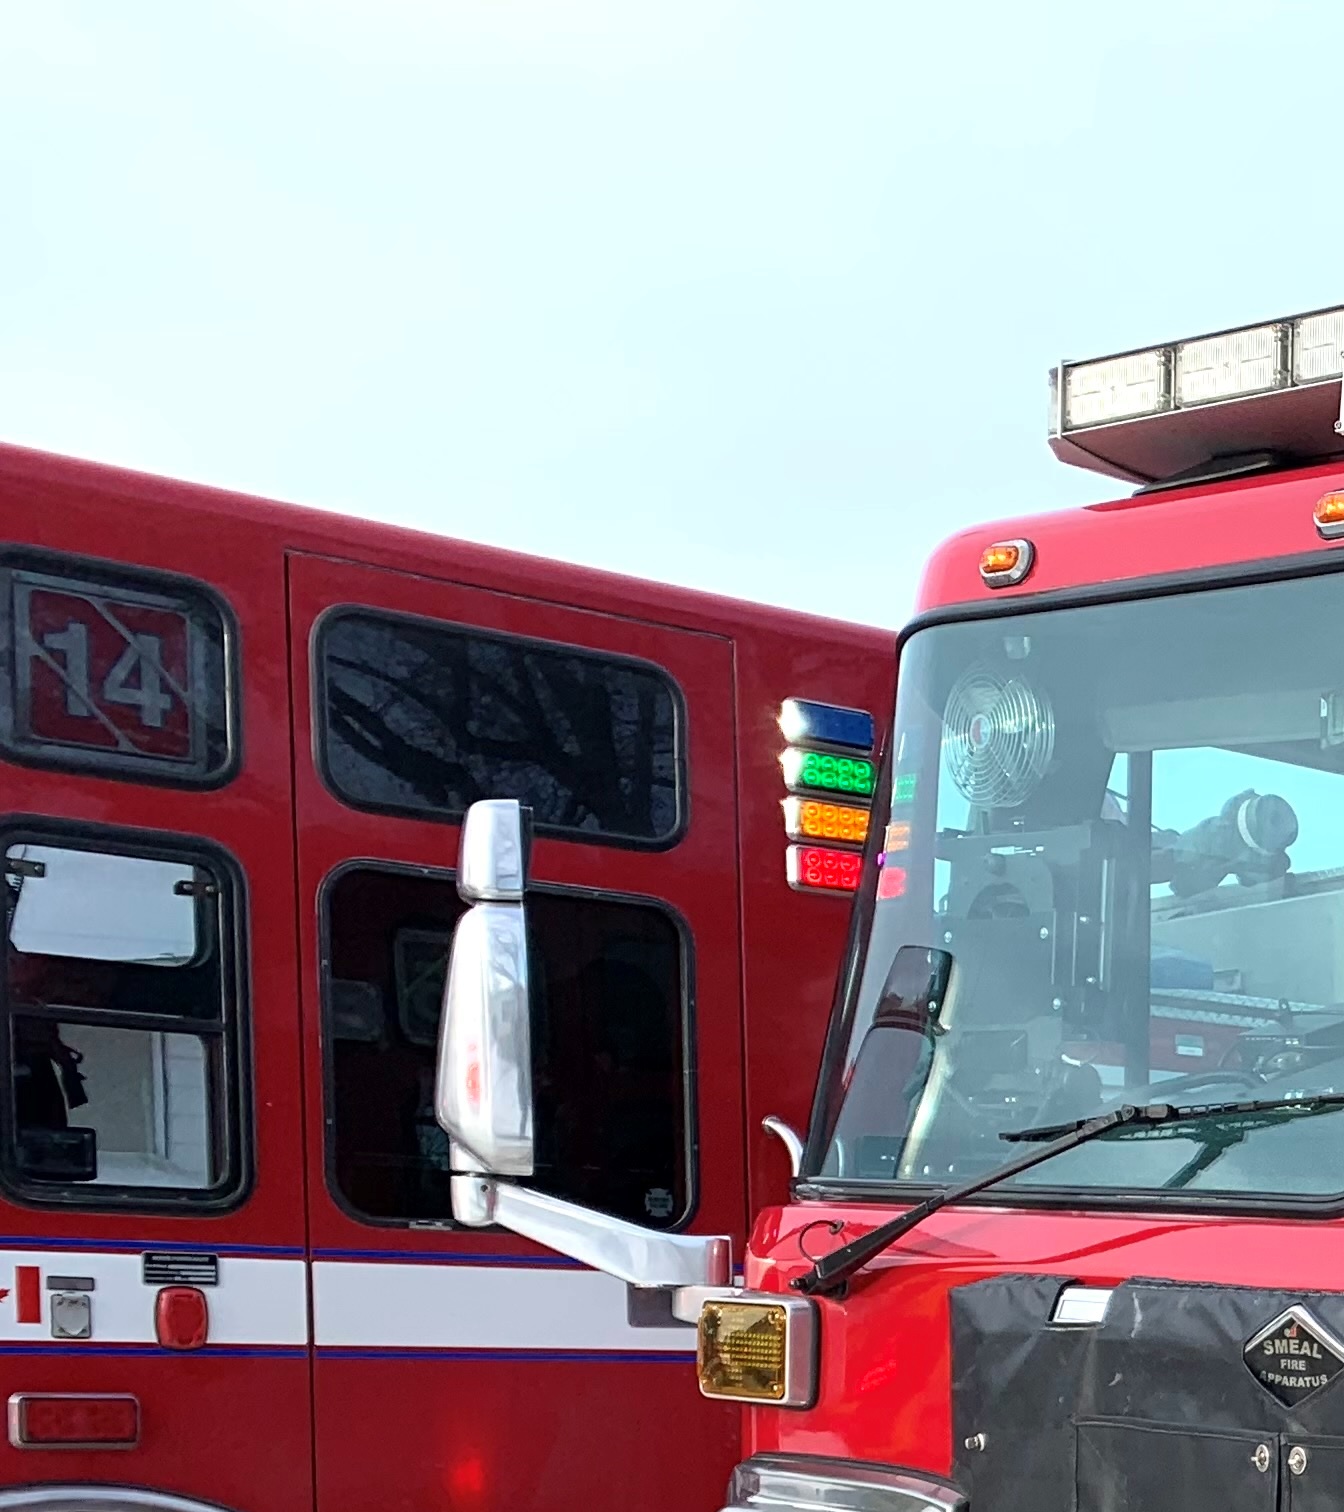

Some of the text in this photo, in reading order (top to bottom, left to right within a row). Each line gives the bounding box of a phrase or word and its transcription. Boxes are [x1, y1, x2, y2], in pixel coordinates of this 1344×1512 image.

[42, 617, 172, 729] 14
[1263, 1339, 1322, 1359] SMEAL
[1280, 1359, 1306, 1371] FIRE
[1260, 1371, 1328, 1388] APPARATUS
